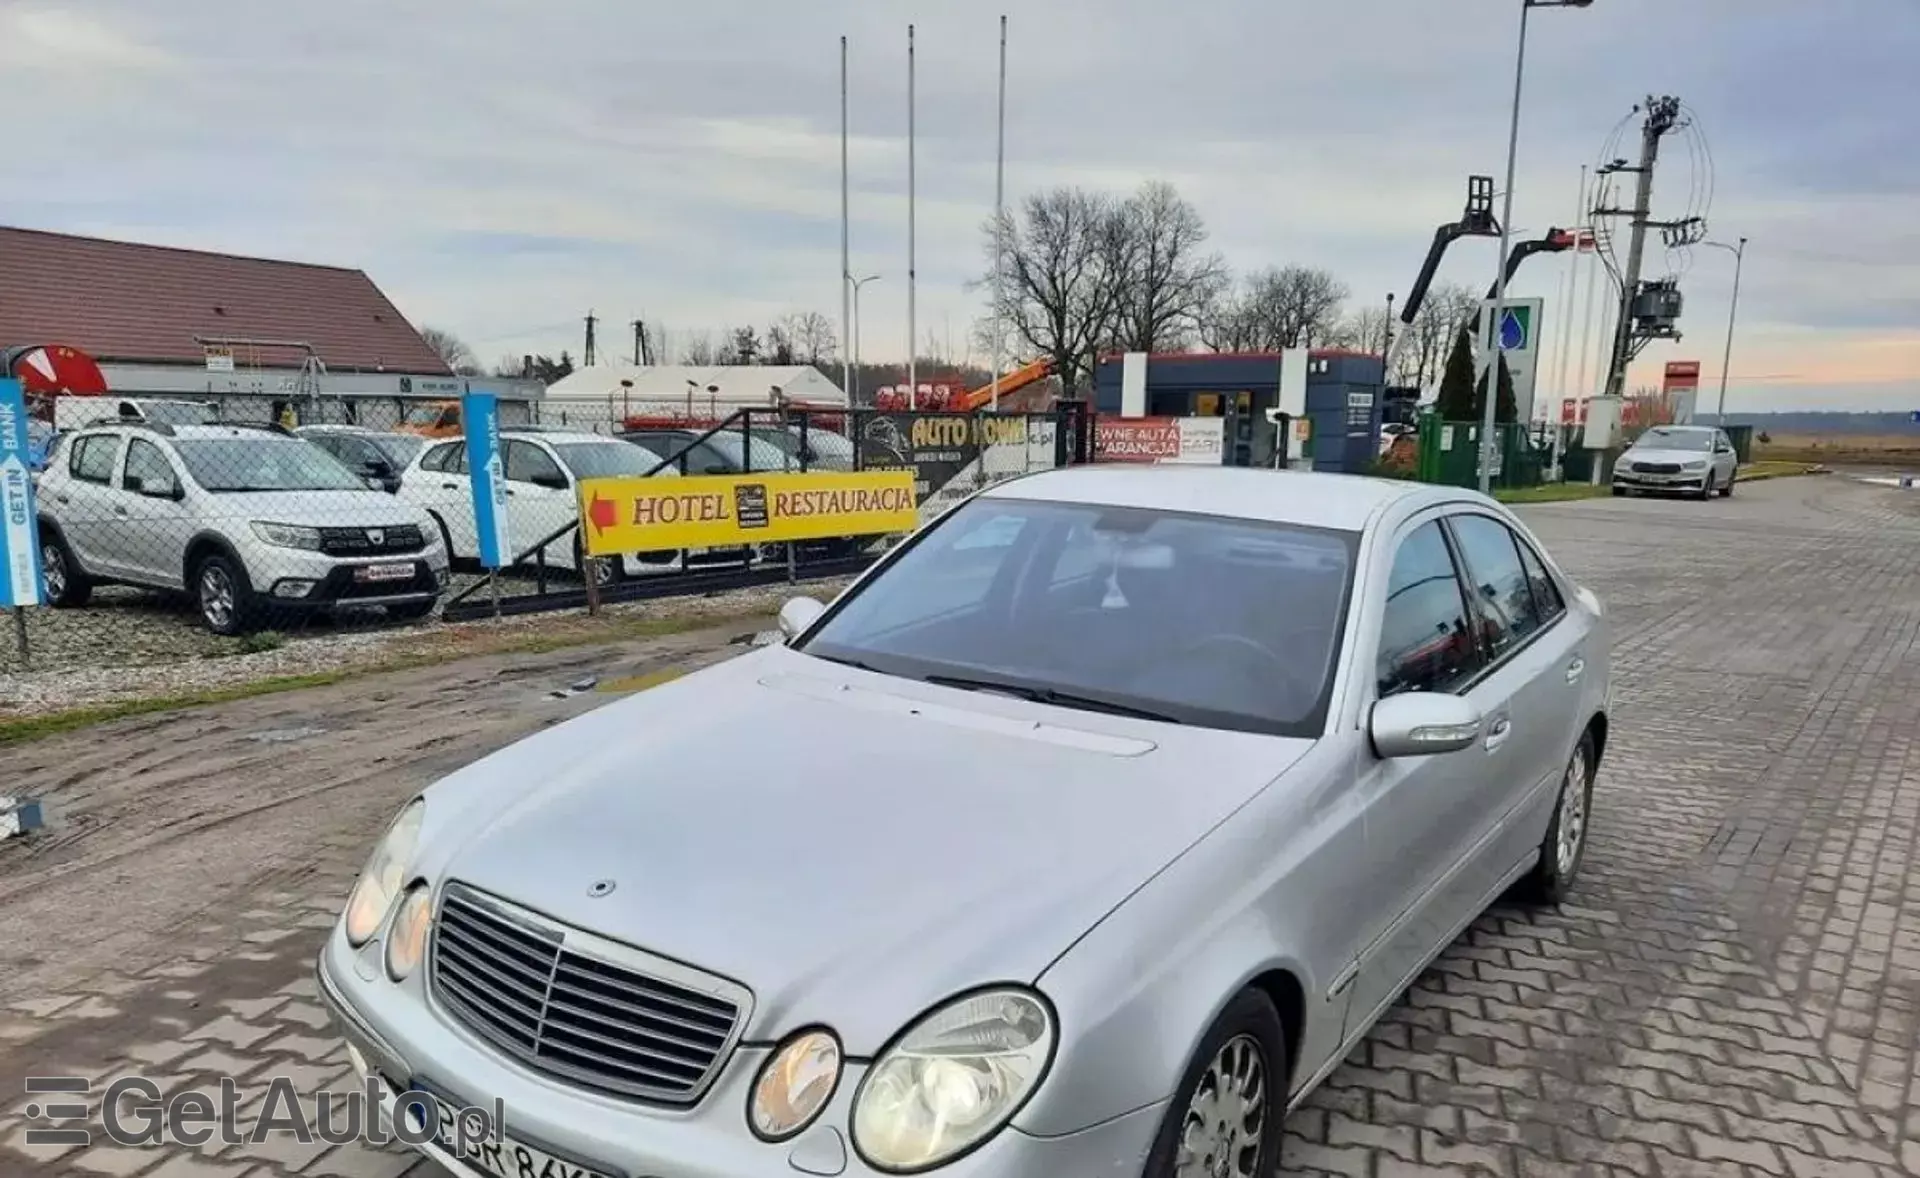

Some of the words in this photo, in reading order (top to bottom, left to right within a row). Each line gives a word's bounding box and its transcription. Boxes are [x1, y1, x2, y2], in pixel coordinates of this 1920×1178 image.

[0, 402, 18, 448] BANK
[911, 417, 967, 448] AUTO
[1137, 427, 1178, 441] AUTA
[8, 467, 22, 488] IN
[9, 489, 26, 525] GET
[632, 495, 730, 525] HOTEL
[774, 487, 913, 518] RESTAURACJA
